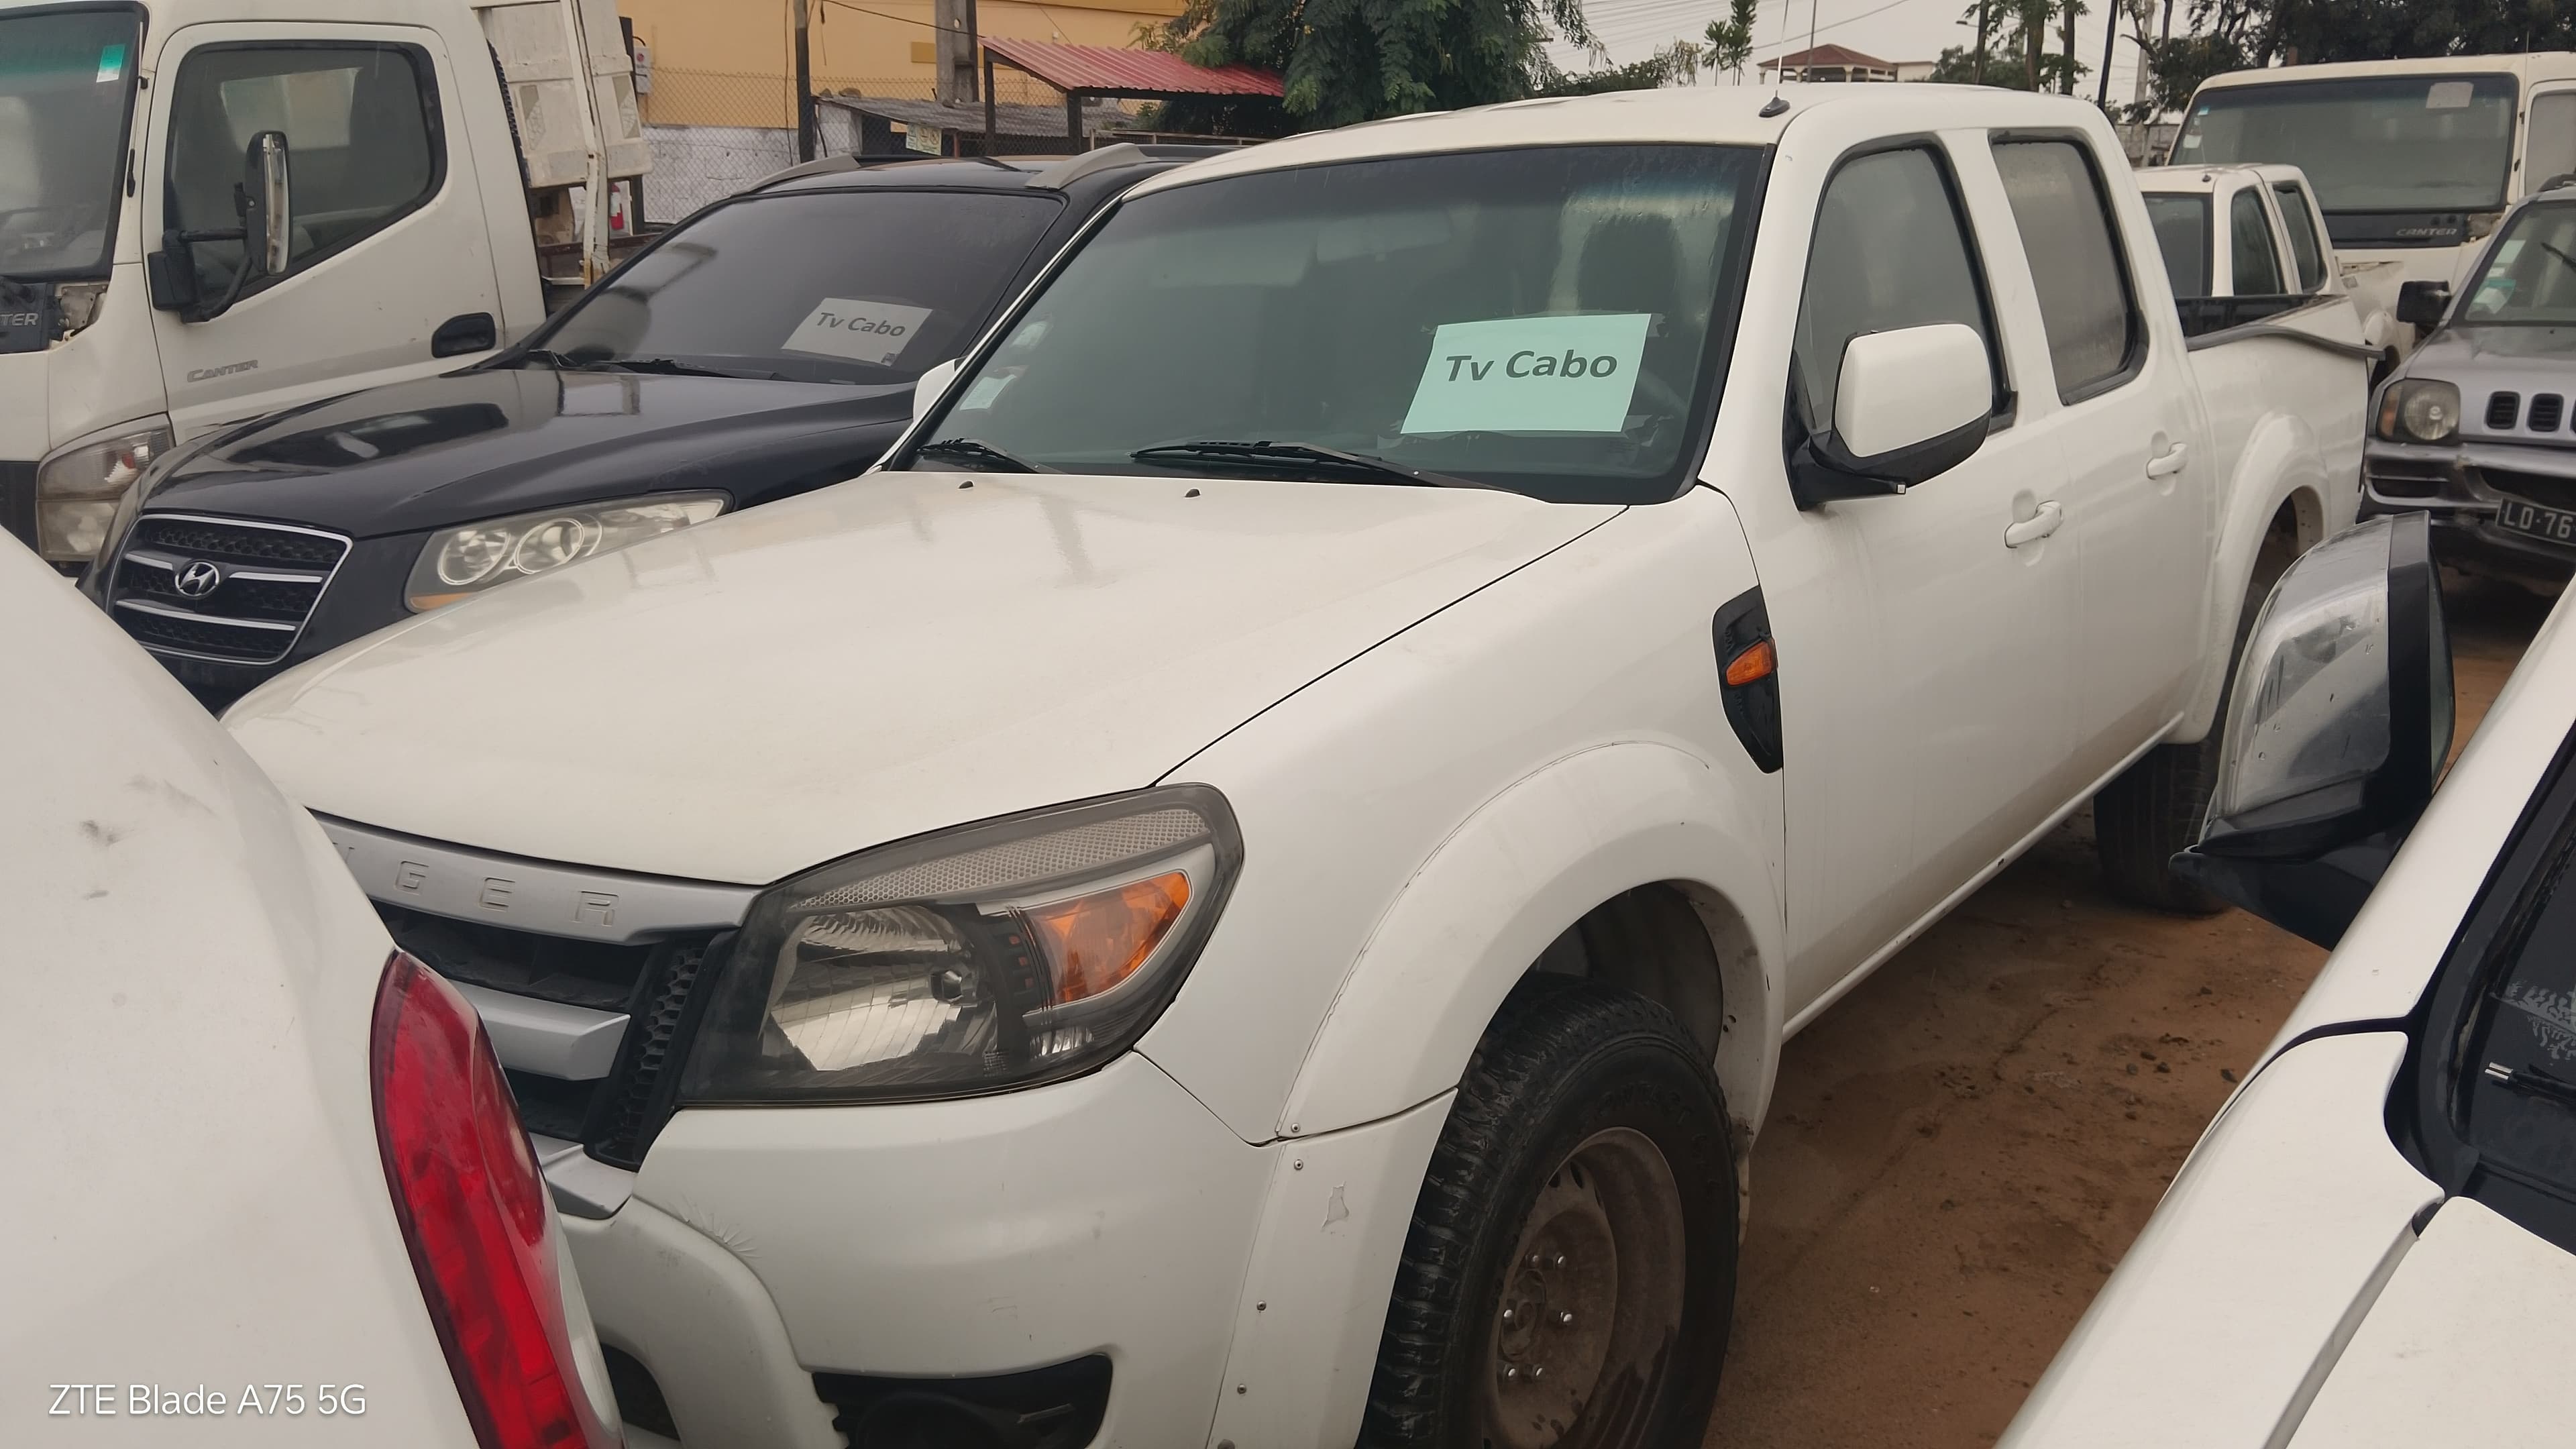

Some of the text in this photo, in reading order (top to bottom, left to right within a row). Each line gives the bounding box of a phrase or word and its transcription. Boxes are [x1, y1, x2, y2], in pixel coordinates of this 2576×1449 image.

[2396, 228, 2457, 236] CANTER
[0, 313, 39, 326] TER
[817, 312, 906, 336] Tv Cabo
[1446, 350, 1617, 382] Tv Cabo
[333, 842, 619, 927] GER
